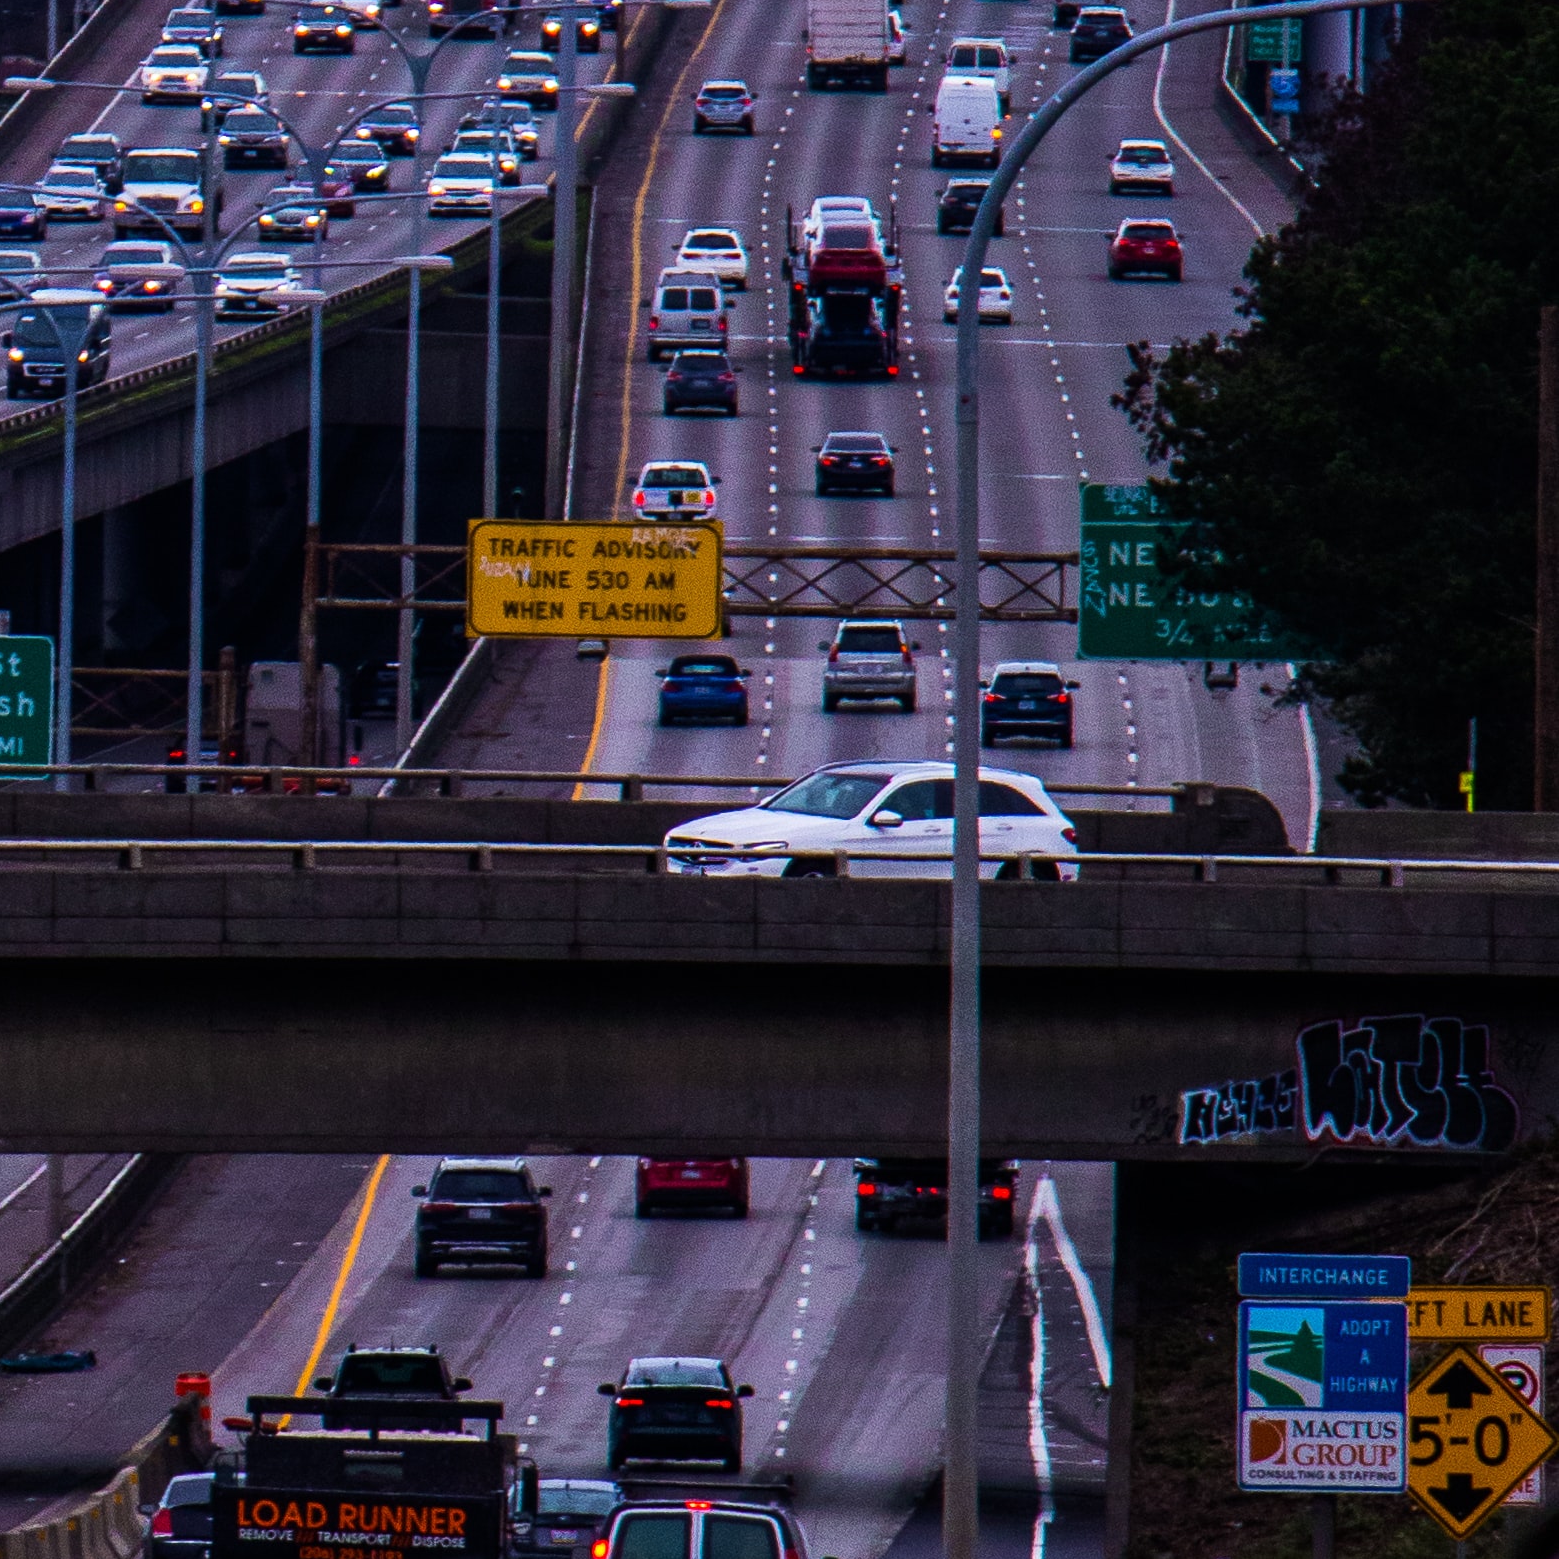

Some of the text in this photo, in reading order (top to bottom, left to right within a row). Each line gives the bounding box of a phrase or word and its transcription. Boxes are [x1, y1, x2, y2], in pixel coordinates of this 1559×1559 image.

[488, 537, 701, 560] TRAFFIC ADVISORY
[1109, 542, 1155, 567] NE
[586, 570, 630, 590] 530
[644, 570, 677, 591] AM
[1109, 582, 1156, 607] NE
[502, 600, 687, 622] WHEN FLASHING
[1259, 1266, 1389, 1285] INTERCHANGE
[1463, 1300, 1534, 1327] LANE
[1340, 1319, 1392, 1336] ADOPT
[1360, 1348, 1370, 1365] A
[1330, 1376, 1399, 1393] HIGHWAY
[1292, 1419, 1397, 1439] MACTUS
[1292, 1443, 1397, 1467] GROUP
[1248, 1469, 1397, 1482] CONSULTING & STAFFING
[237, 1499, 467, 1535] LOAD RUNNER
[238, 1528, 466, 1548] REMOVE TRANSPORT DISPOSE
